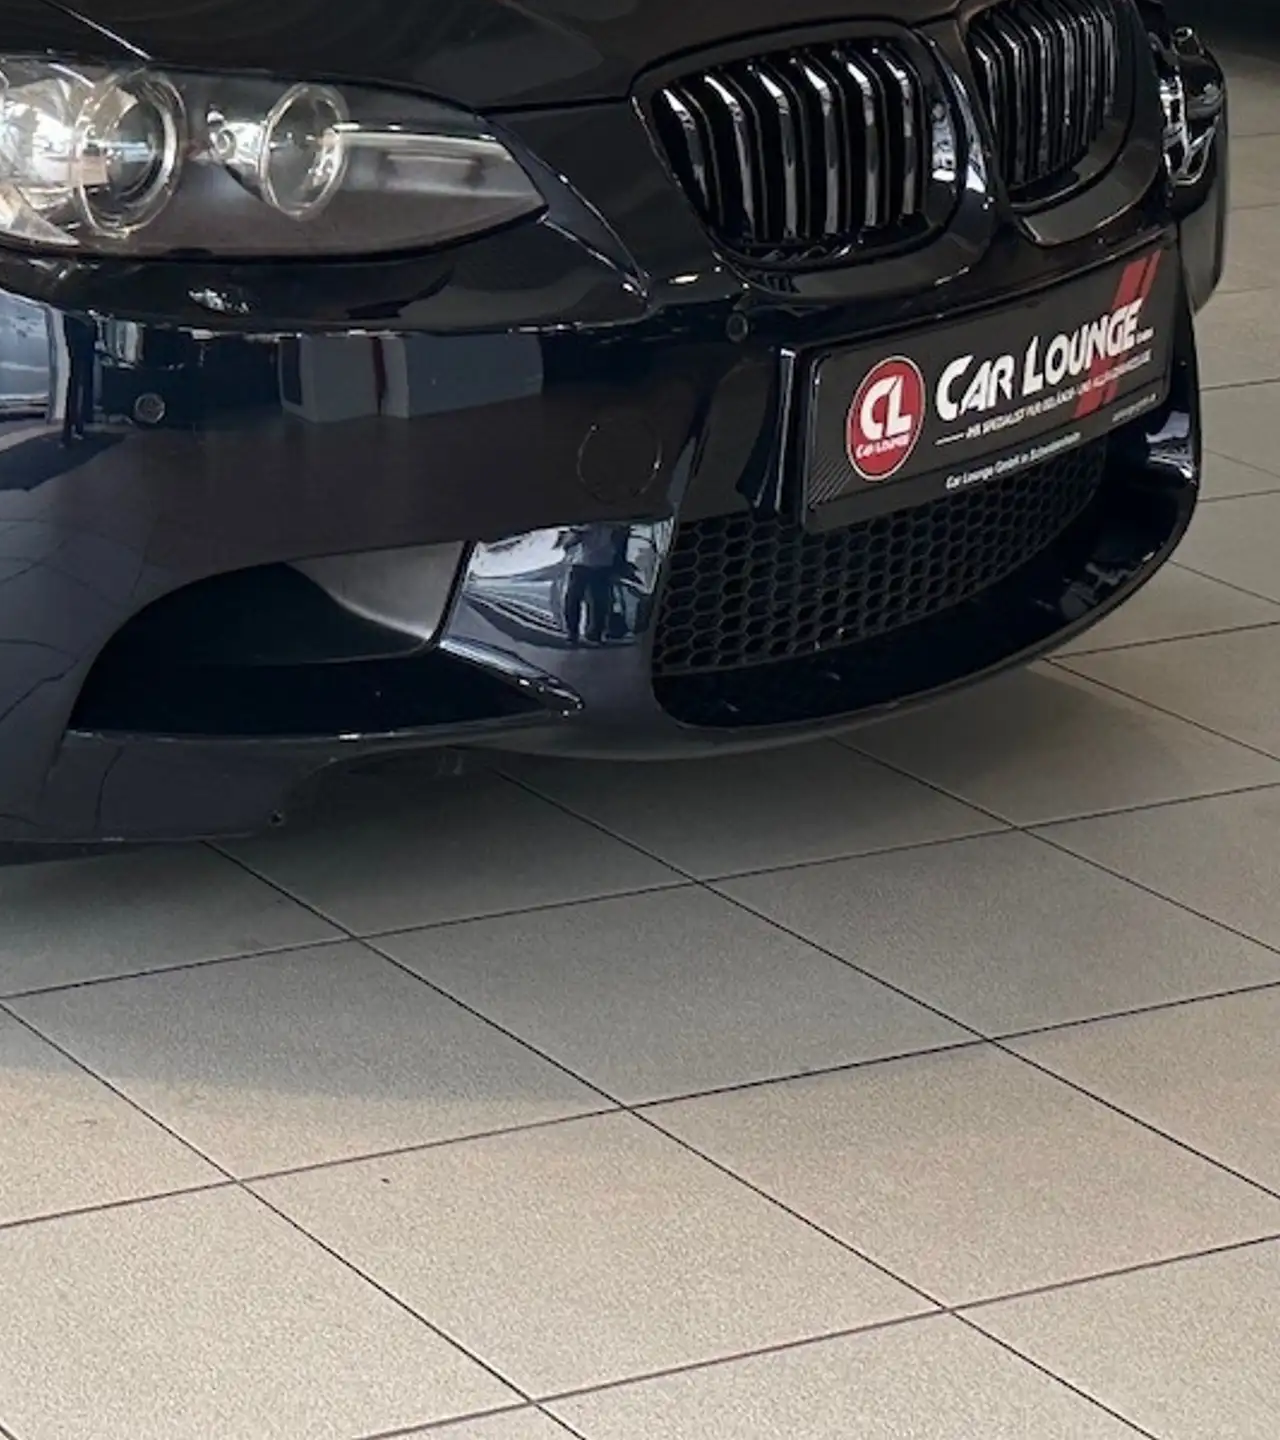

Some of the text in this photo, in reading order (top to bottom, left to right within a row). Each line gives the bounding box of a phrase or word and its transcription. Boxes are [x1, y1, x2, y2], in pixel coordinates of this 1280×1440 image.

[860, 374, 912, 441] CL
[935, 354, 1015, 422] CAR
[1022, 297, 1144, 397] LOUNGE
